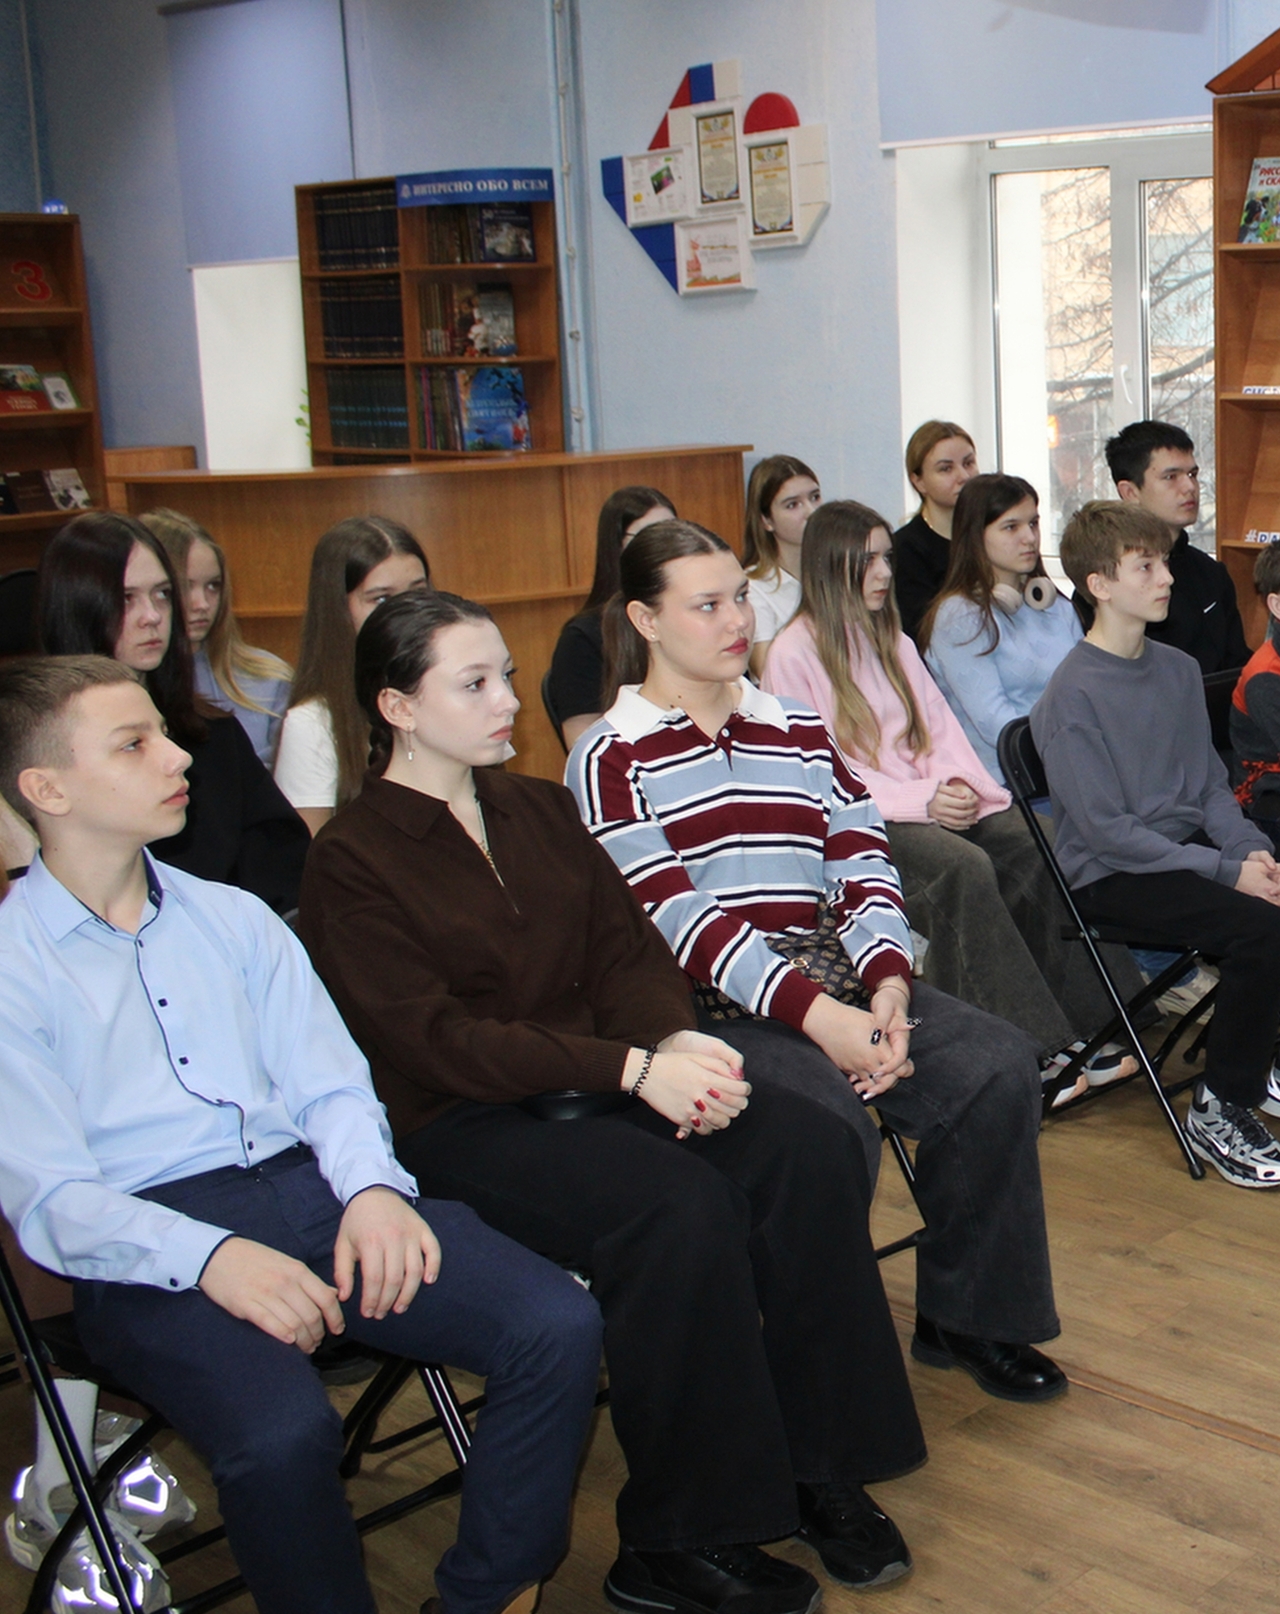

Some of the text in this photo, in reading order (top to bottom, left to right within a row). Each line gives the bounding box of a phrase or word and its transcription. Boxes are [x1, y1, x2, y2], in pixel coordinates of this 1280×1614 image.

[412, 178, 549, 197] ИНТЕРЕСНО ОБО ВСЕМ
[12, 260, 51, 300] 3
